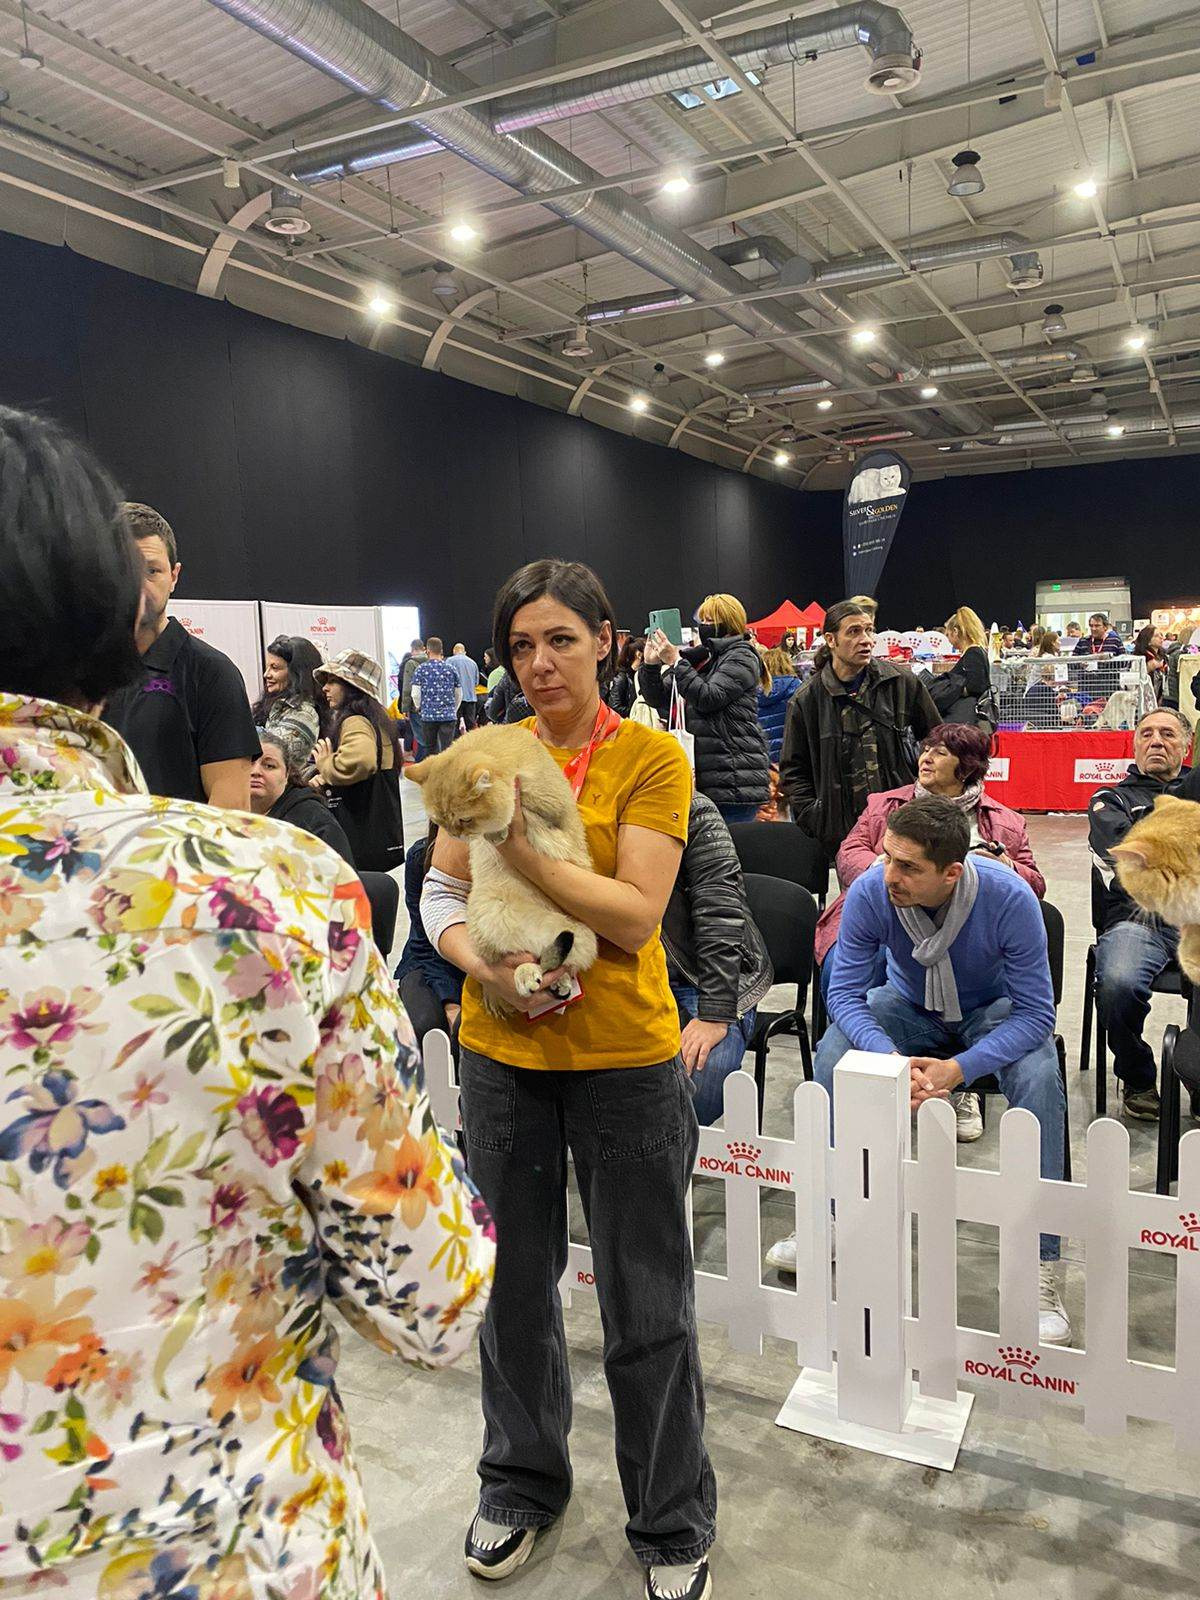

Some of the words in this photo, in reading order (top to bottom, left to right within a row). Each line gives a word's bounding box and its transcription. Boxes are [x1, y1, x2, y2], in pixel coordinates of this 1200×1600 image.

[699, 1156, 742, 1175] ROYAL
[745, 1164, 791, 1184] CANIN
[1141, 1229, 1199, 1251] ROYAL
[965, 1359, 1017, 1383] ROYAL
[1020, 1372, 1075, 1395] CANIN
